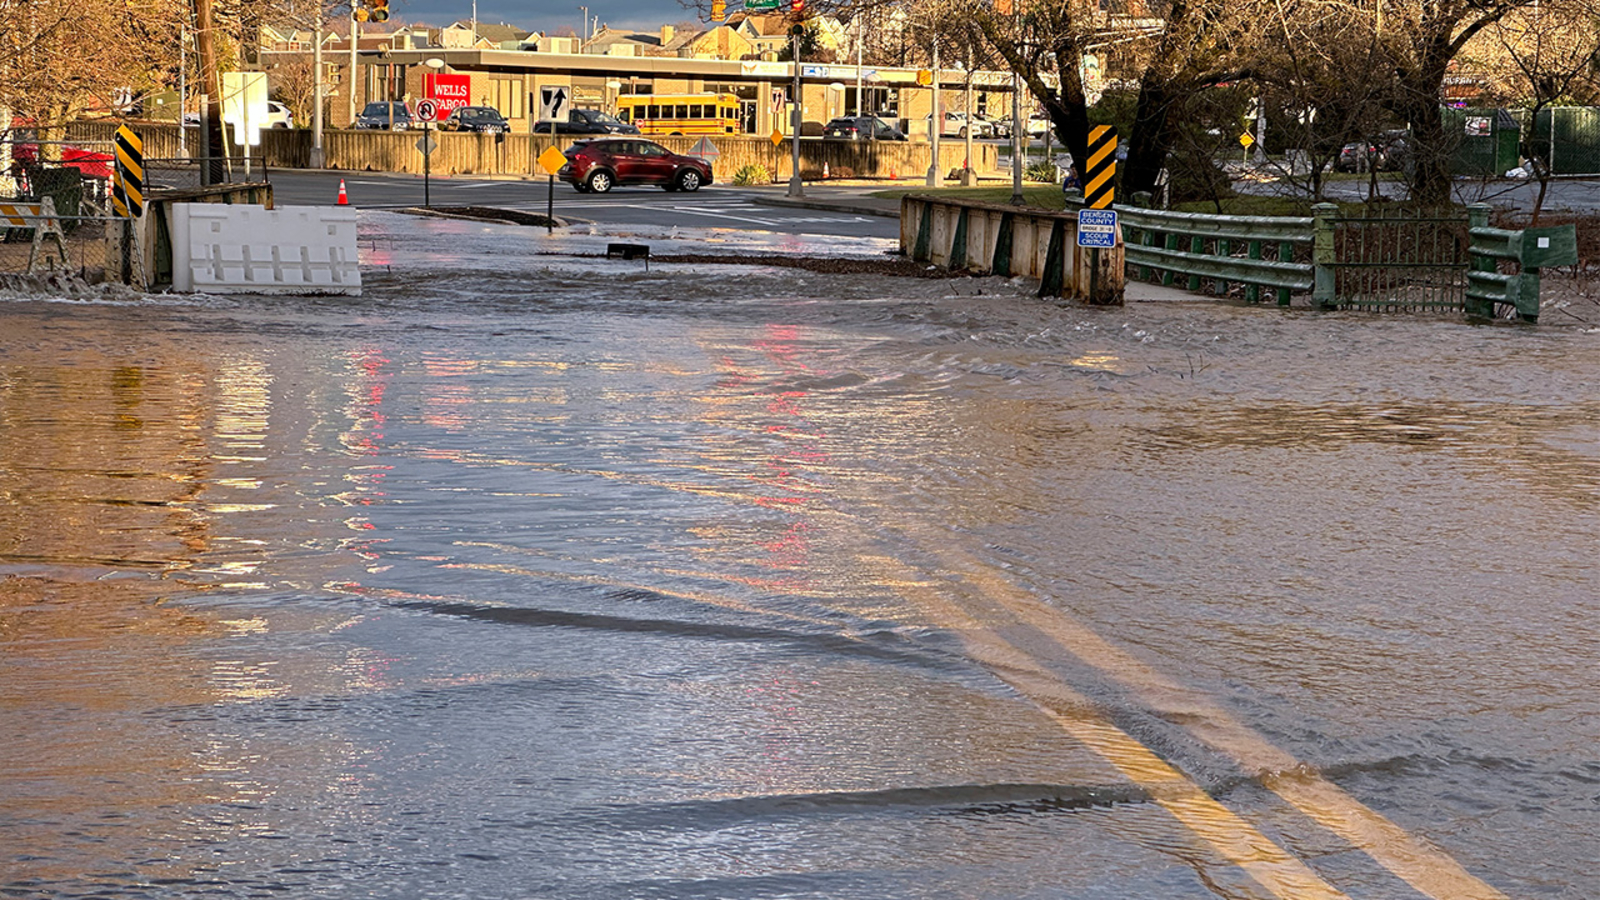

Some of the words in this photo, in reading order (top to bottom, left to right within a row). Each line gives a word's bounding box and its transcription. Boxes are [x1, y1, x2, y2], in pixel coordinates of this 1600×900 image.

[435, 84, 467, 96] WELLS
[1082, 211, 1114, 219] BERGEN
[1081, 238, 1113, 246] CRITICAL
